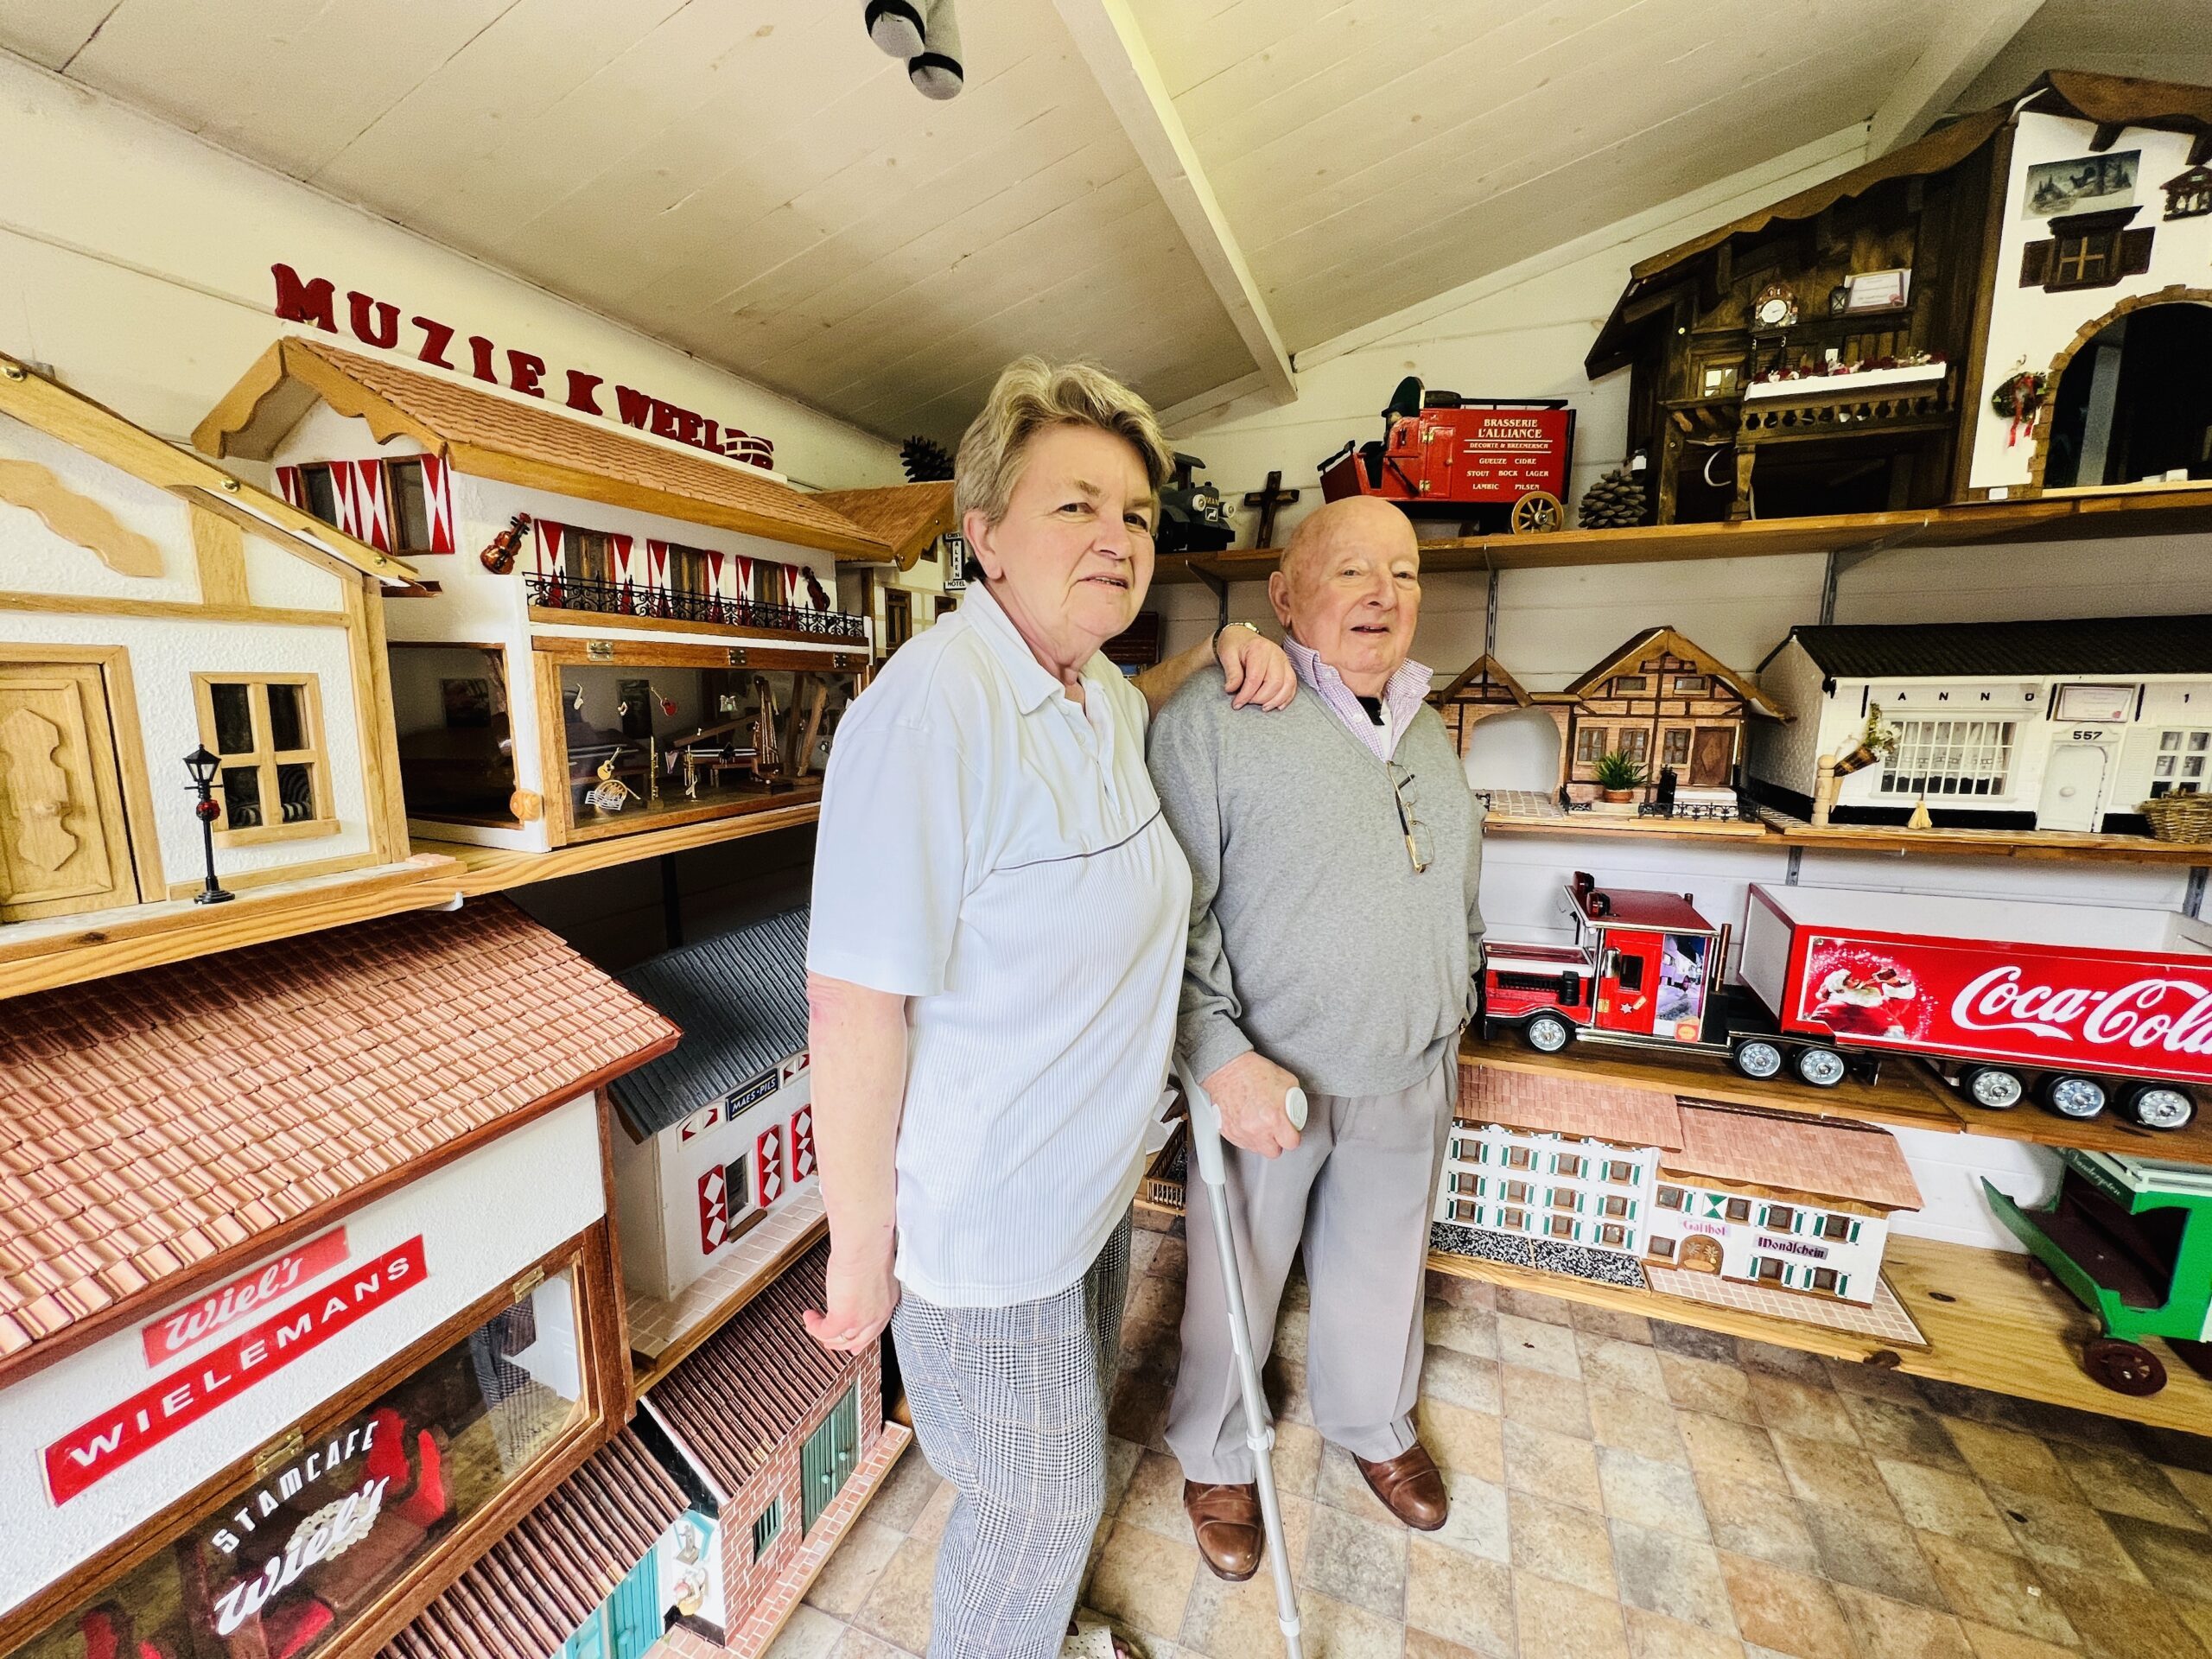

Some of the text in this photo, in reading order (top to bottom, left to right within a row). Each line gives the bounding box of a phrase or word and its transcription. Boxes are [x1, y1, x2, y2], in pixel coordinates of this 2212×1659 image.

[270, 263, 603, 416] MUZIEK
[1478, 429, 1542, 438] L'ALLIANCE
[1484, 418, 1538, 427] BRASSERIE
[1897, 692, 2035, 702] ANNO
[2073, 730, 2103, 741] 557
[164, 1254, 306, 1351] Wiel's
[70, 1256, 410, 1467] WIELEMANS
[212, 1420, 379, 1554] STAMCAFE
[213, 1476, 391, 1637] Wiel's
